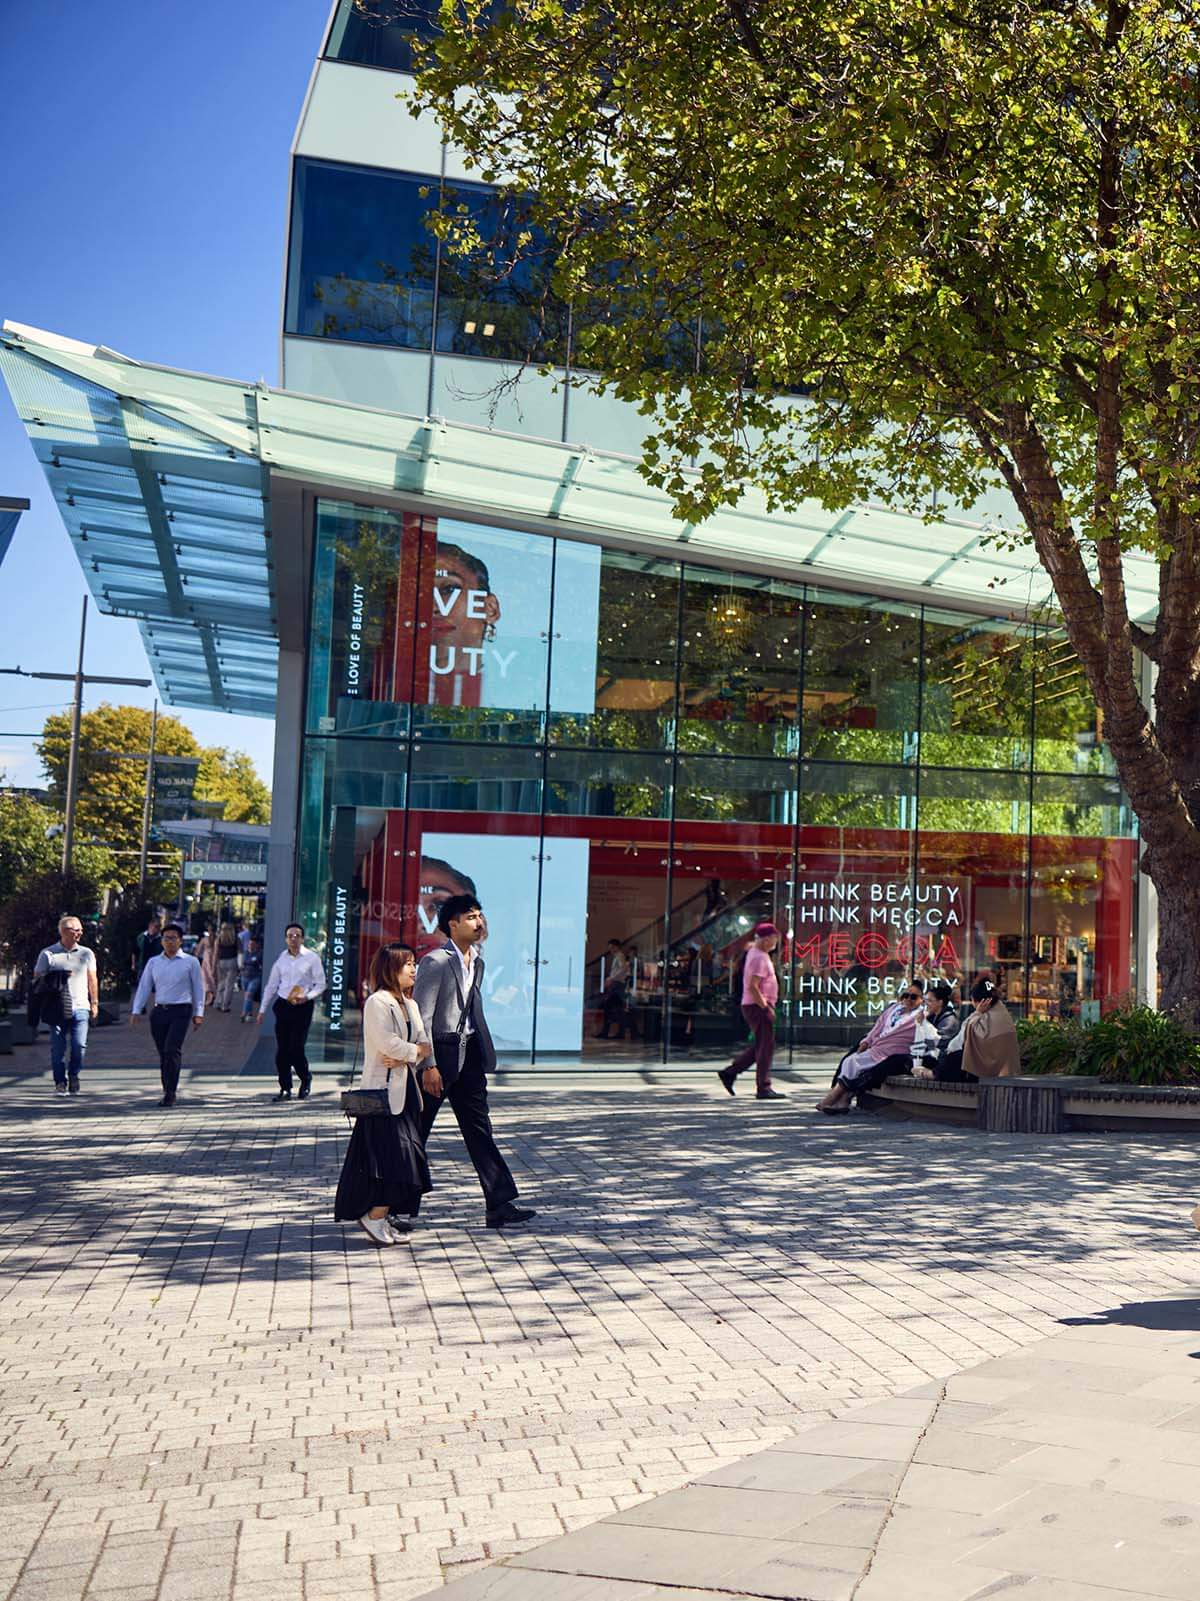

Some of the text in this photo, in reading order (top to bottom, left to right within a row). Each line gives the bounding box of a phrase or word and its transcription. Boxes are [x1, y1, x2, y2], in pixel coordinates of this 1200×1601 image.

[352, 583, 364, 631] BEAUTY
[350, 633, 361, 651] OF
[348, 654, 360, 685] LOVE
[430, 645, 518, 678] UTY
[785, 881, 960, 903] THINK BEAUTY
[335, 886, 348, 933] BEAUTY
[785, 904, 960, 927] THINK MECCA
[334, 937, 345, 955] OF
[784, 932, 961, 969] MECCA
[332, 958, 344, 990] LOVE
[783, 976, 858, 996] THINK
[331, 994, 342, 1018] THE
[782, 1000, 857, 1019] THINK
